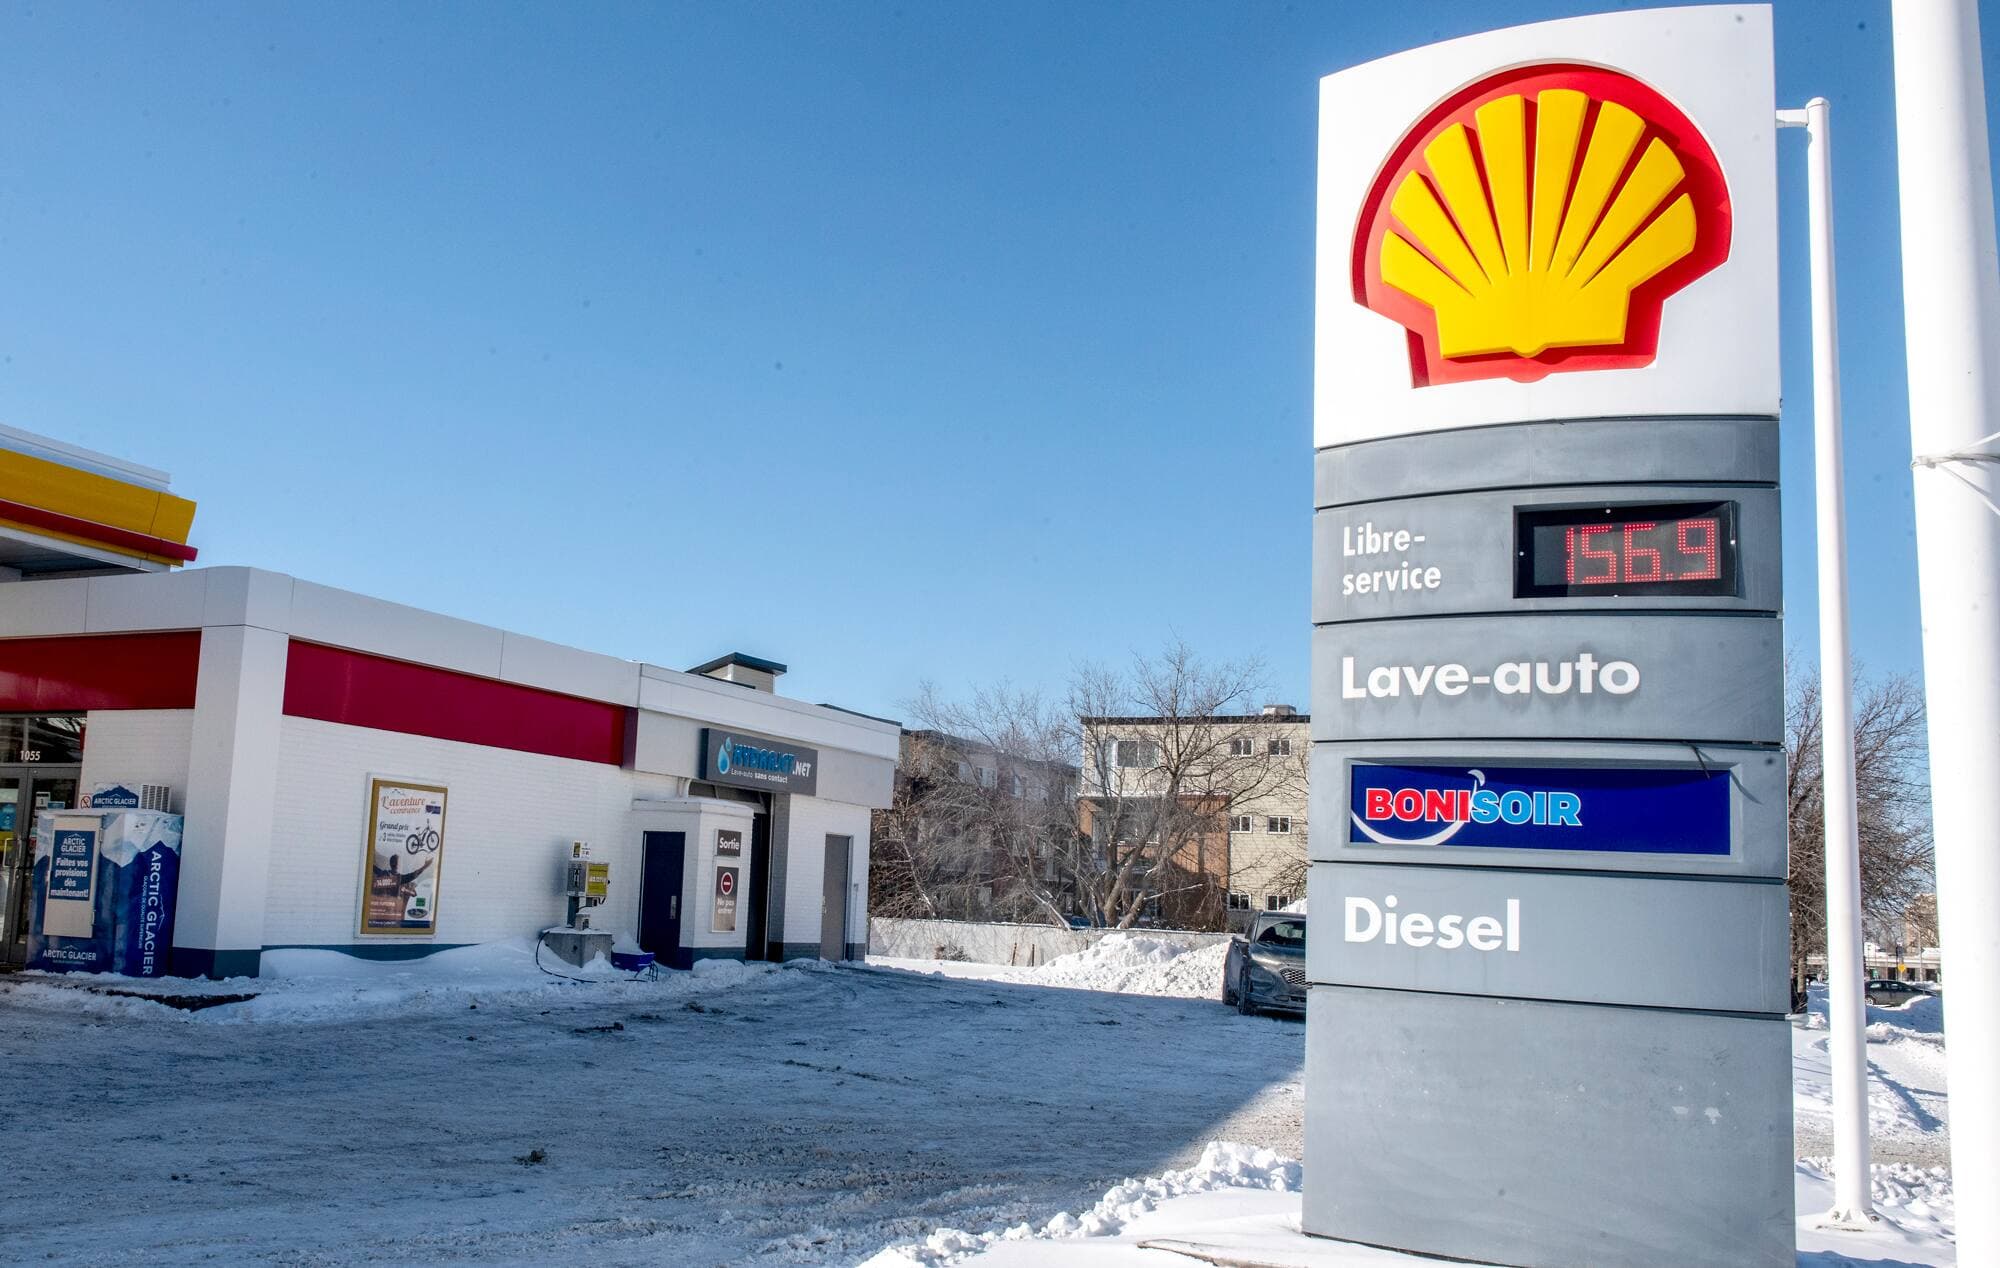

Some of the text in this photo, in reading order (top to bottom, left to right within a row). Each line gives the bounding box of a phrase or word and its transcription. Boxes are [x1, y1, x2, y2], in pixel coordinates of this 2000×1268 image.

[1343, 522, 1426, 556] Libre-
[1565, 519, 1716, 584] 156.9
[1342, 560, 1442, 596] service
[1342, 653, 1641, 699] Lave-auto
[20, 750, 41, 761] 1055
[754, 771, 767, 780] sans
[768, 774, 788, 784] contact
[94, 797, 137, 806] ARCTIC GLACIER
[63, 838, 86, 846] ARCTIC
[719, 837, 740, 850] Sortie
[61, 845, 87, 853] GLACIER
[56, 857, 88, 867] Faites vos
[55, 868, 88, 878] provisions
[50, 888, 89, 898] maintenant!
[142, 851, 161, 975] ARCTIC GLACIER
[1344, 895, 1521, 952] Diesel
[42, 949, 97, 961] ARCTIC GLACIER
